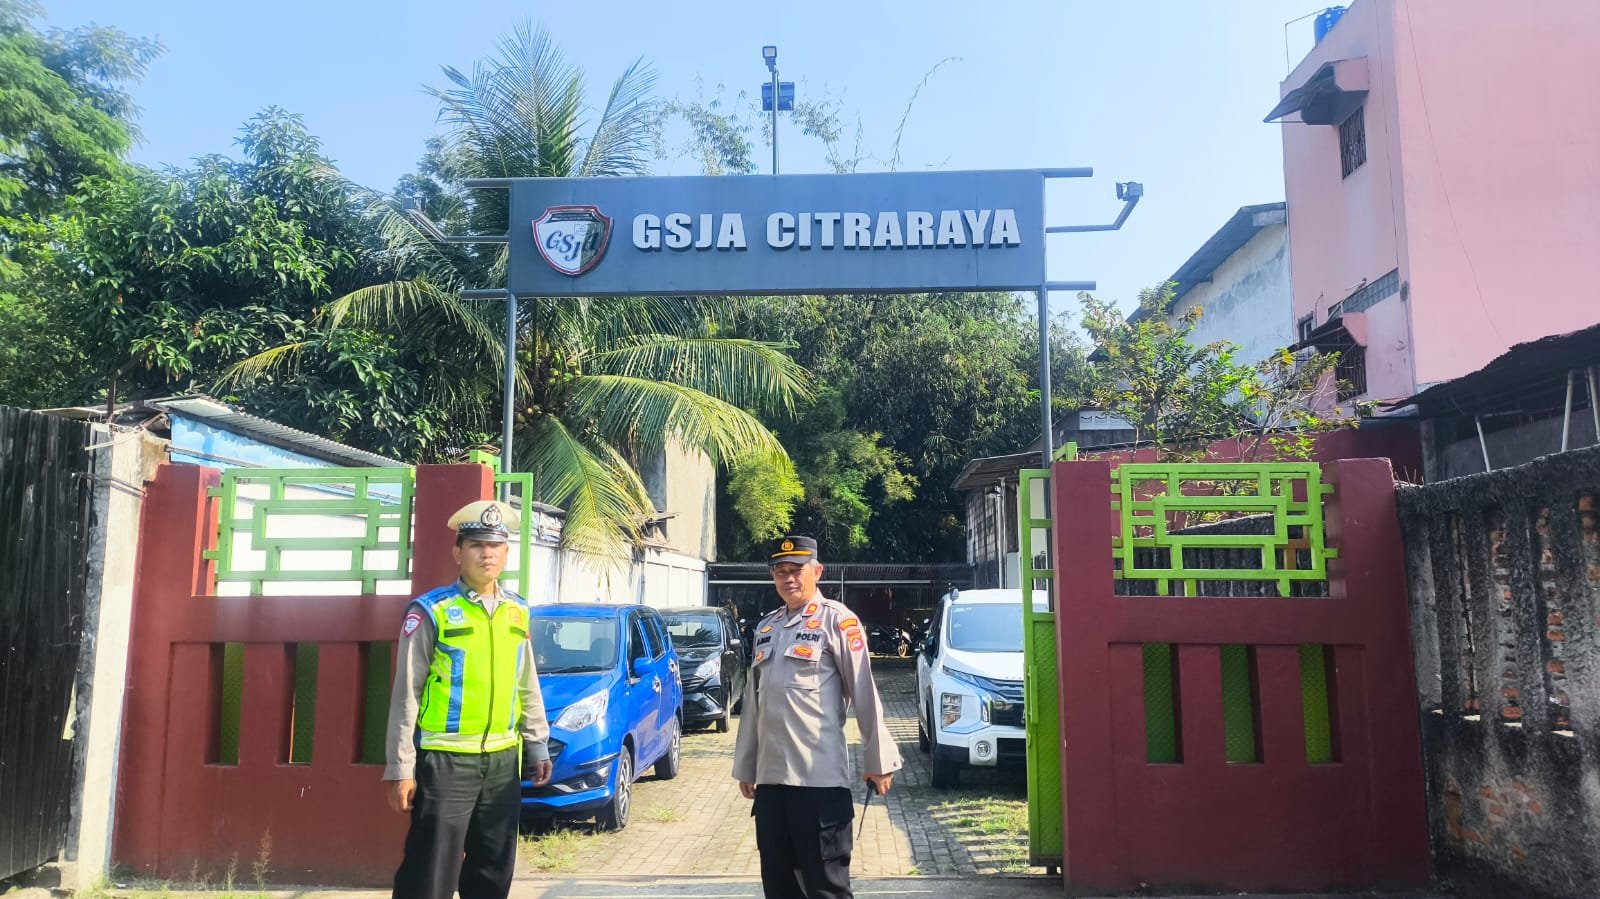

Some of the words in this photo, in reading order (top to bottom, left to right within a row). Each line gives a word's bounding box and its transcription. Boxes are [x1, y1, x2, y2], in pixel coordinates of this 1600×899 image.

[632, 212, 747, 250] GSJA
[766, 209, 1021, 250] CITRARAYA
[795, 632, 820, 642] POLRI
